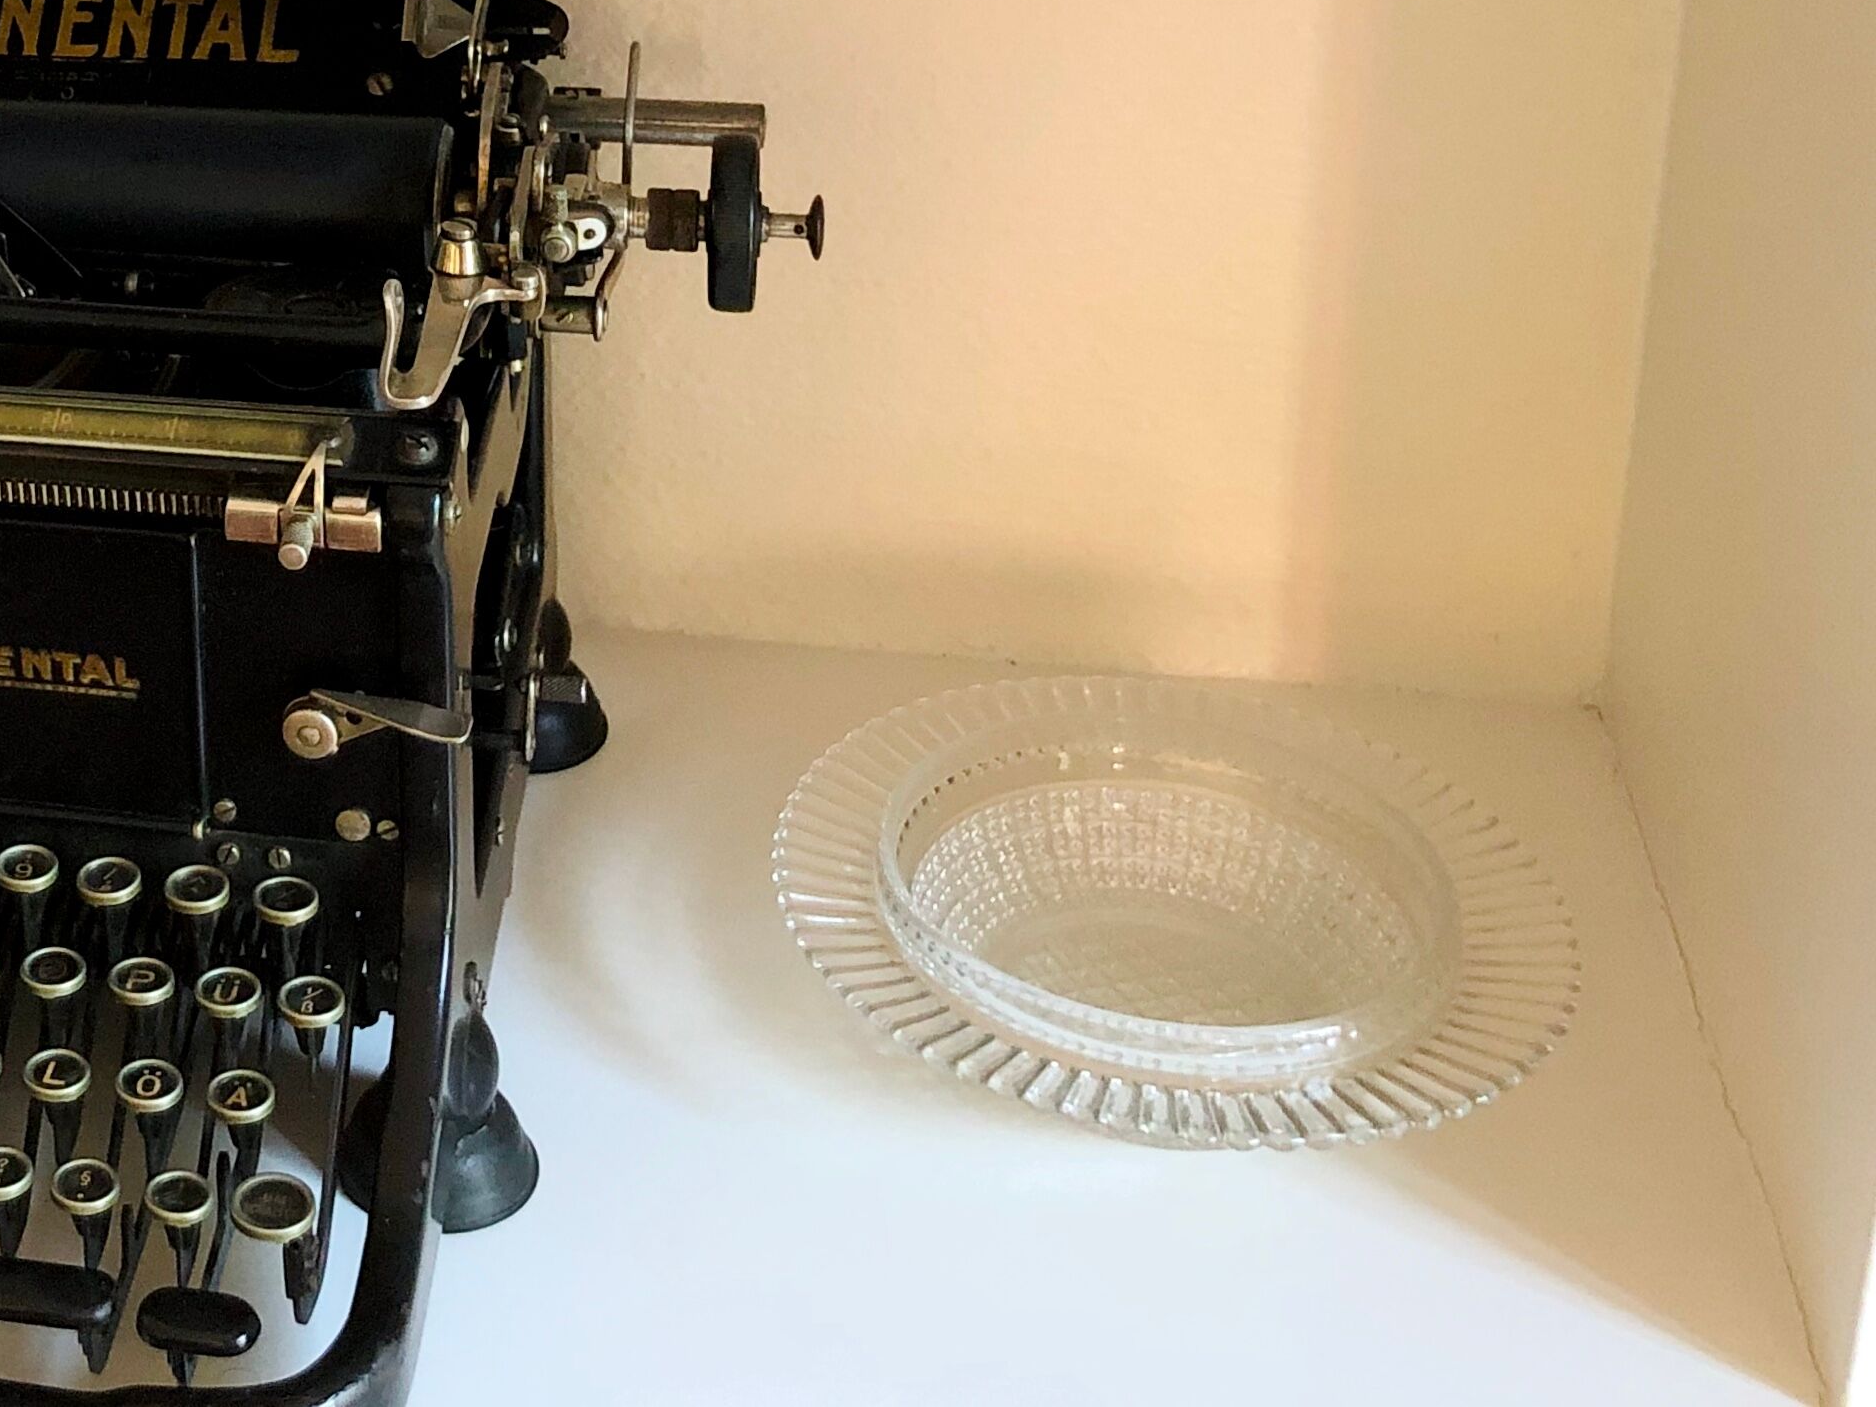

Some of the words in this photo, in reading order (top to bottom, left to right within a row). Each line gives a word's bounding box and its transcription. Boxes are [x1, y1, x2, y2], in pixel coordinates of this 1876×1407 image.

[14, 862, 34, 879] 9
[126, 969, 156, 991] P
[213, 978, 241, 1004] Ü
[42, 1061, 67, 1087] L
[136, 1069, 163, 1097] Ö
[225, 1080, 252, 1107] Ä
